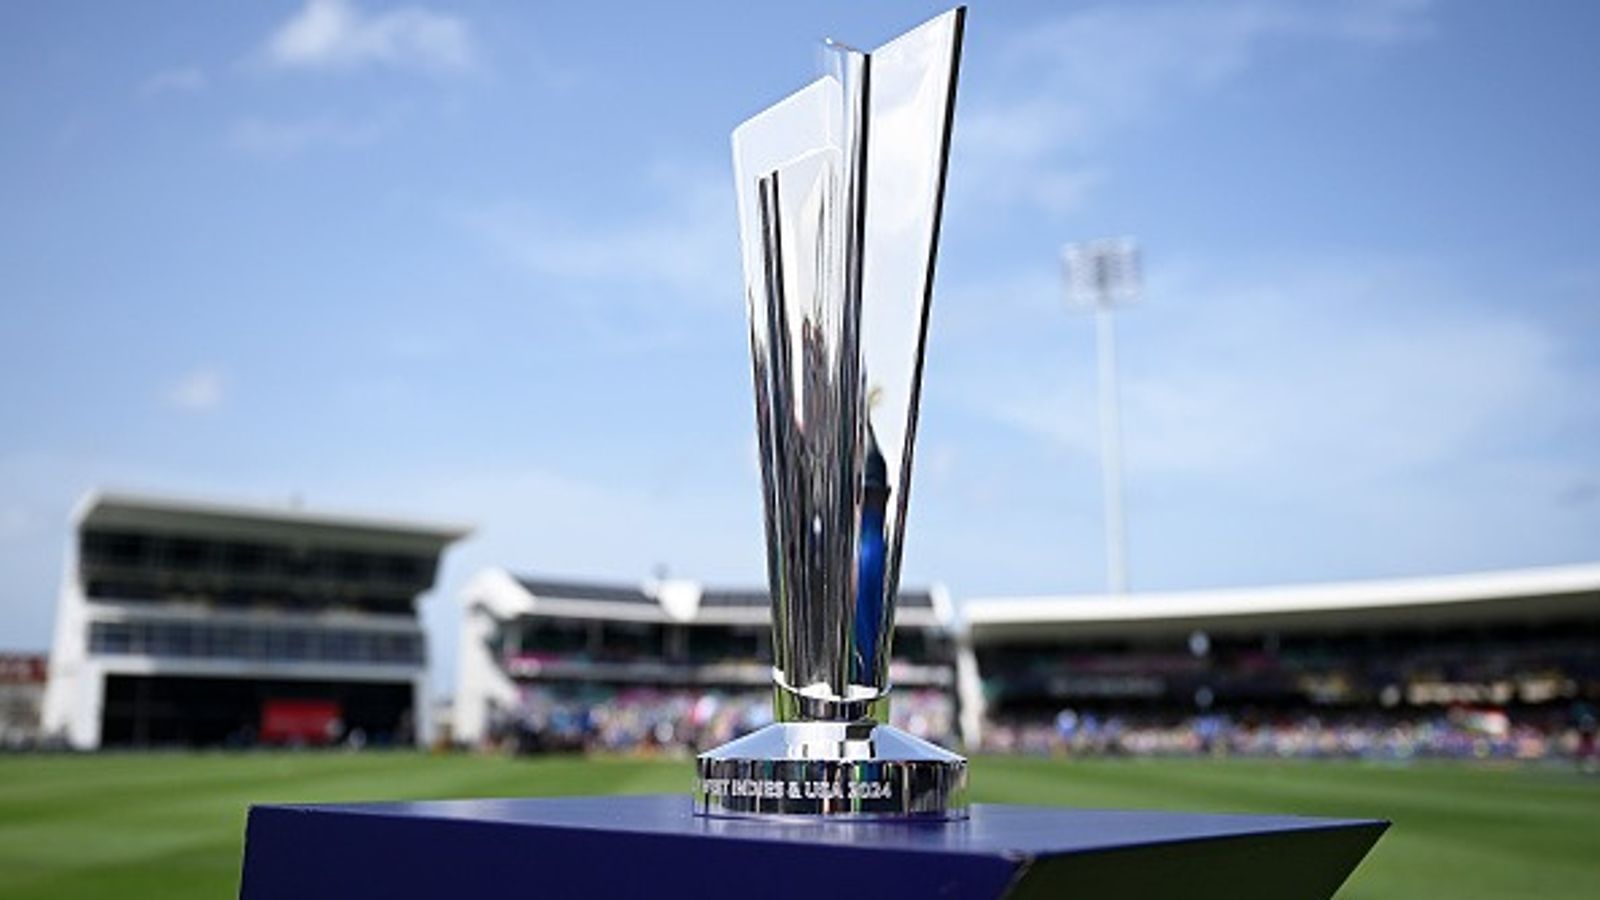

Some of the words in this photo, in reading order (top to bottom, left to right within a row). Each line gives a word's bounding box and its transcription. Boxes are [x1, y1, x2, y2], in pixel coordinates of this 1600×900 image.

[787, 781, 803, 799] &
[804, 781, 844, 799] USA
[847, 781, 892, 799] 2024
